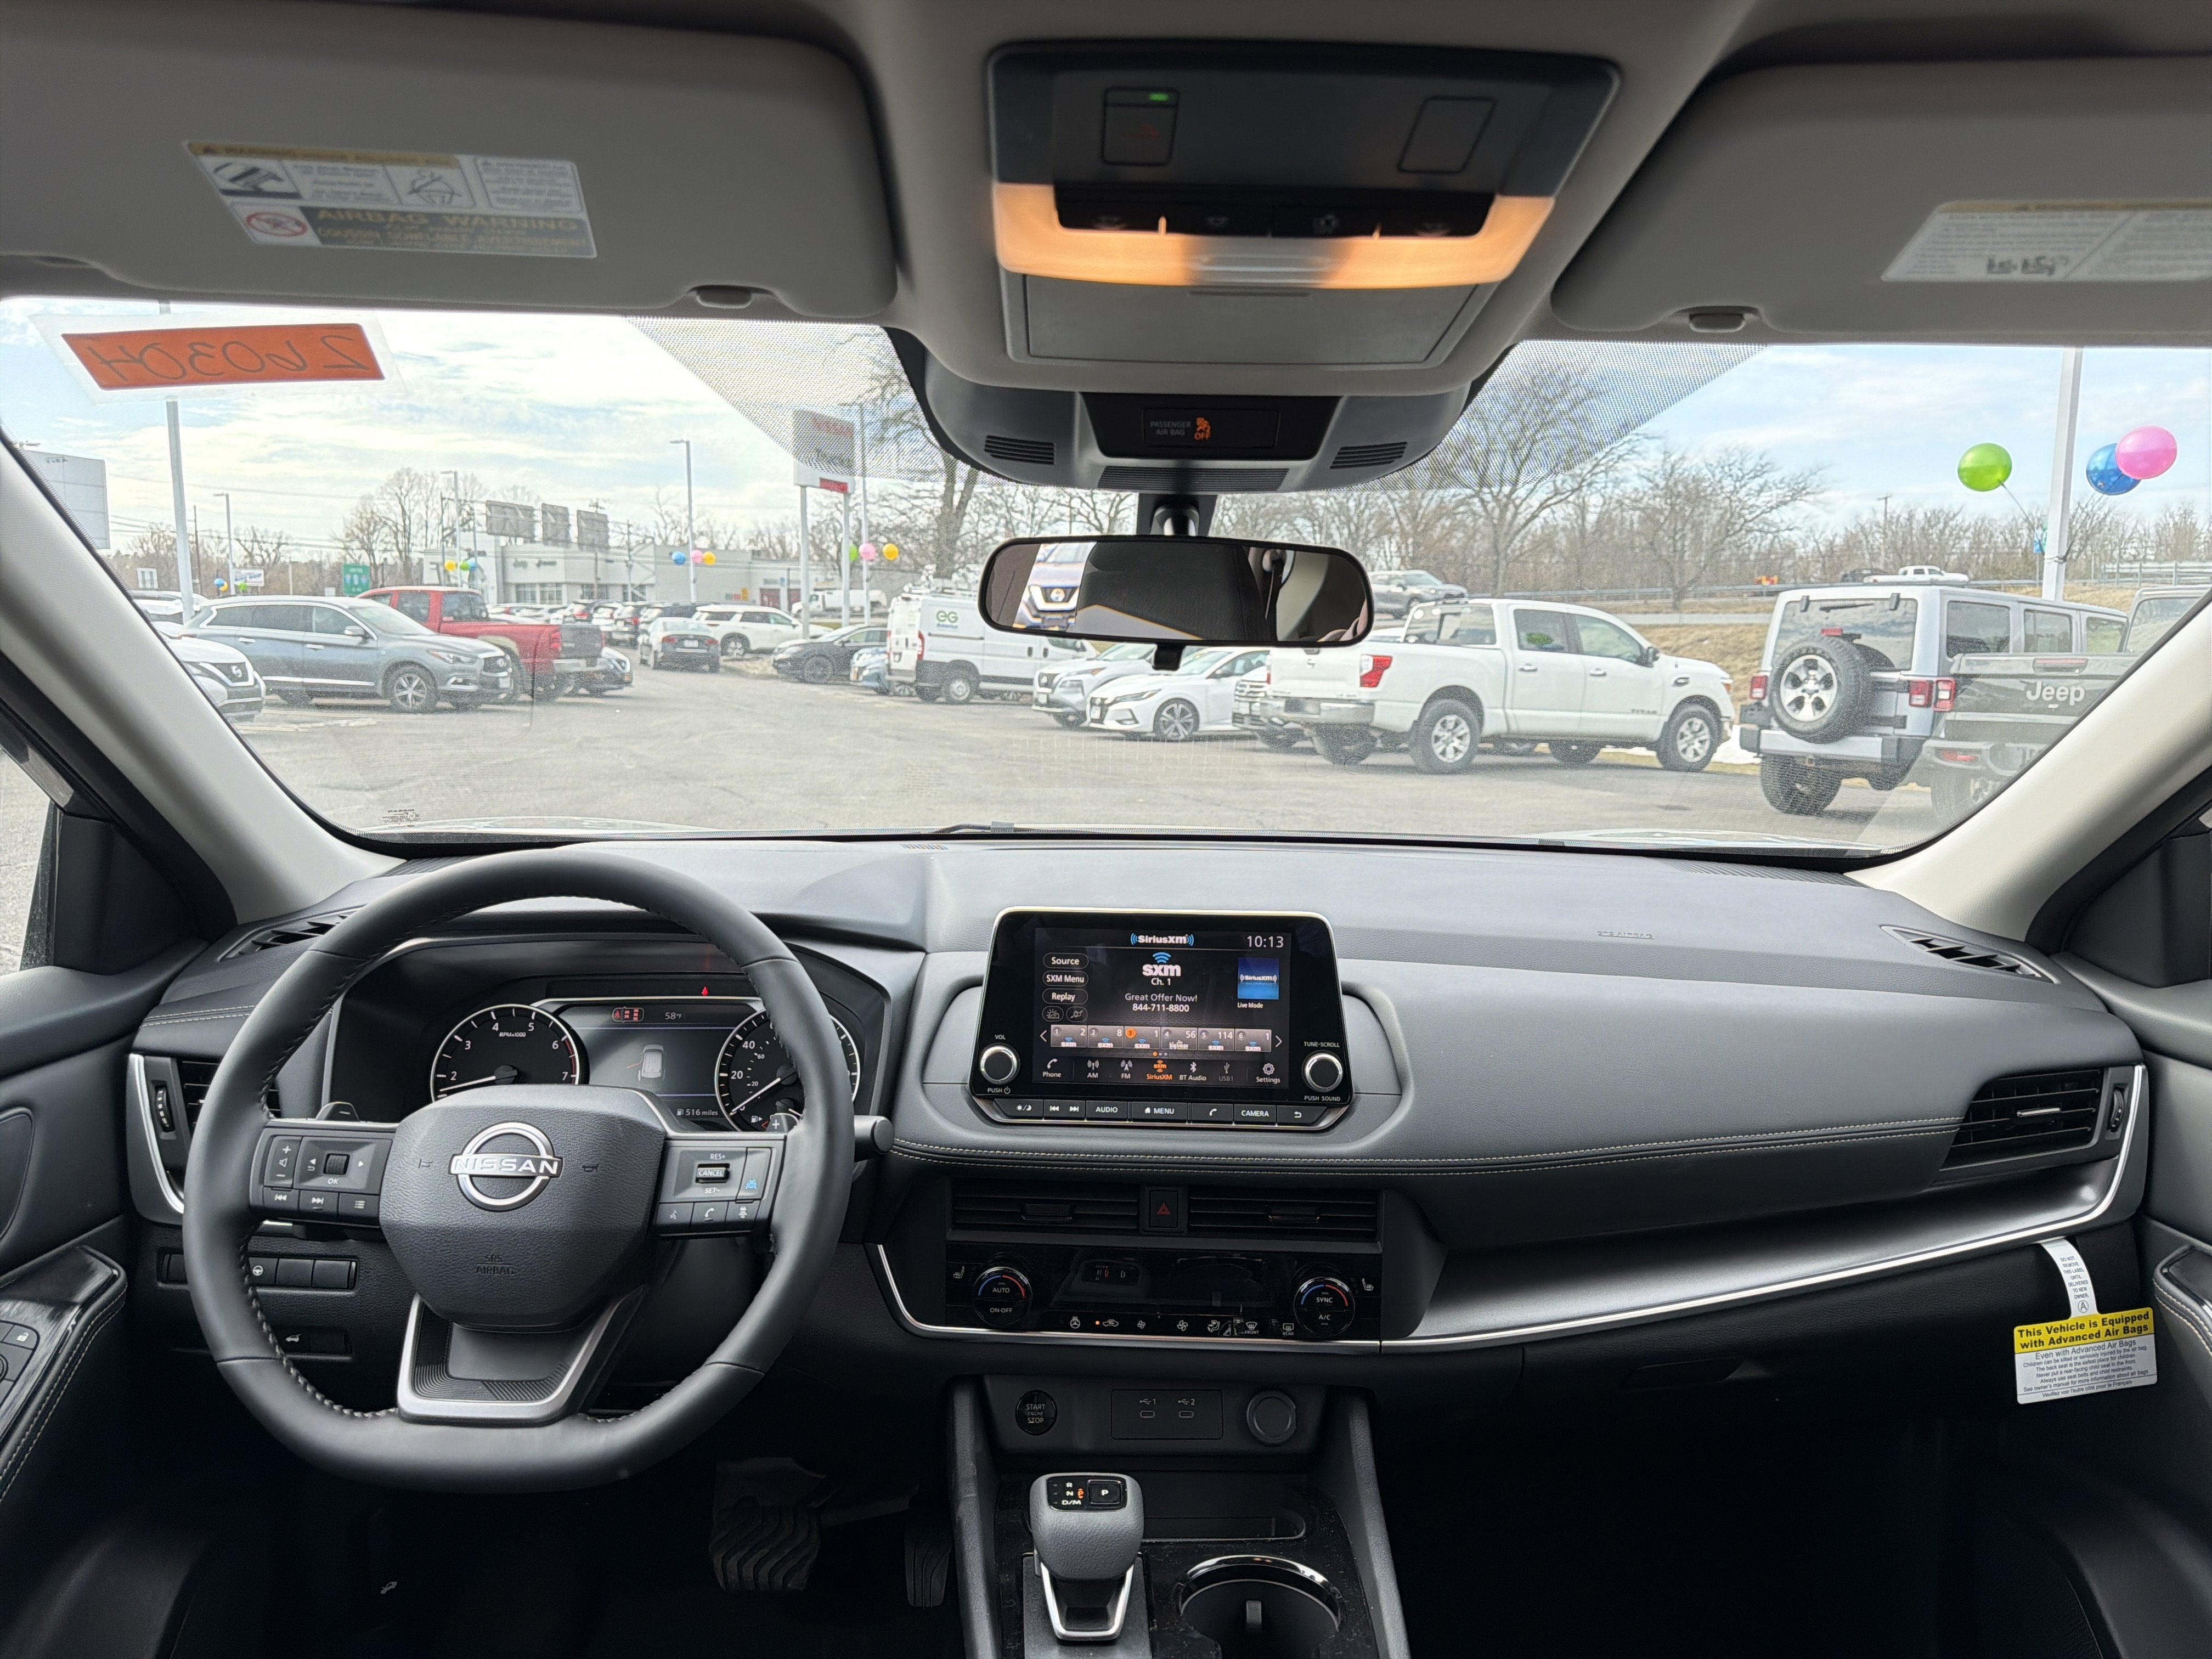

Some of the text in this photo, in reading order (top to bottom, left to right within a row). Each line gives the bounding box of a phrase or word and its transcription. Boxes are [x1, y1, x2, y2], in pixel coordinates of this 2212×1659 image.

[2026, 680, 2085, 706] Jeep
[1247, 935, 1284, 948] 10:13
[1051, 957, 1080, 966] Source
[1052, 992, 1076, 1002] Replay
[1150, 994, 1172, 1002] Offer
[1132, 1003, 1189, 1012] 844-711-8800
[492, 1022, 499, 1031] 4
[528, 1022, 534, 1031] 5
[1080, 1028, 1085, 1036] 2
[465, 1041, 471, 1050] 3
[552, 1040, 558, 1049] 6
[742, 1041, 755, 1049] 40
[1169, 1041, 1189, 1050] highway
[450, 1071, 457, 1081] 2
[562, 1071, 568, 1081] 7
[730, 1071, 743, 1080] 20
[454, 1158, 558, 1175] NISSAN
[486, 1254, 503, 1262] SRS
[476, 1266, 515, 1275] AIRBAG
[2017, 1311, 2149, 1338] This Vehicle is Equipped
[2019, 1323, 2148, 1350] with Advanced Air Bags
[2071, 1342, 2106, 1355] Advanced
[2064, 1366, 2088, 1374] rear-facing
